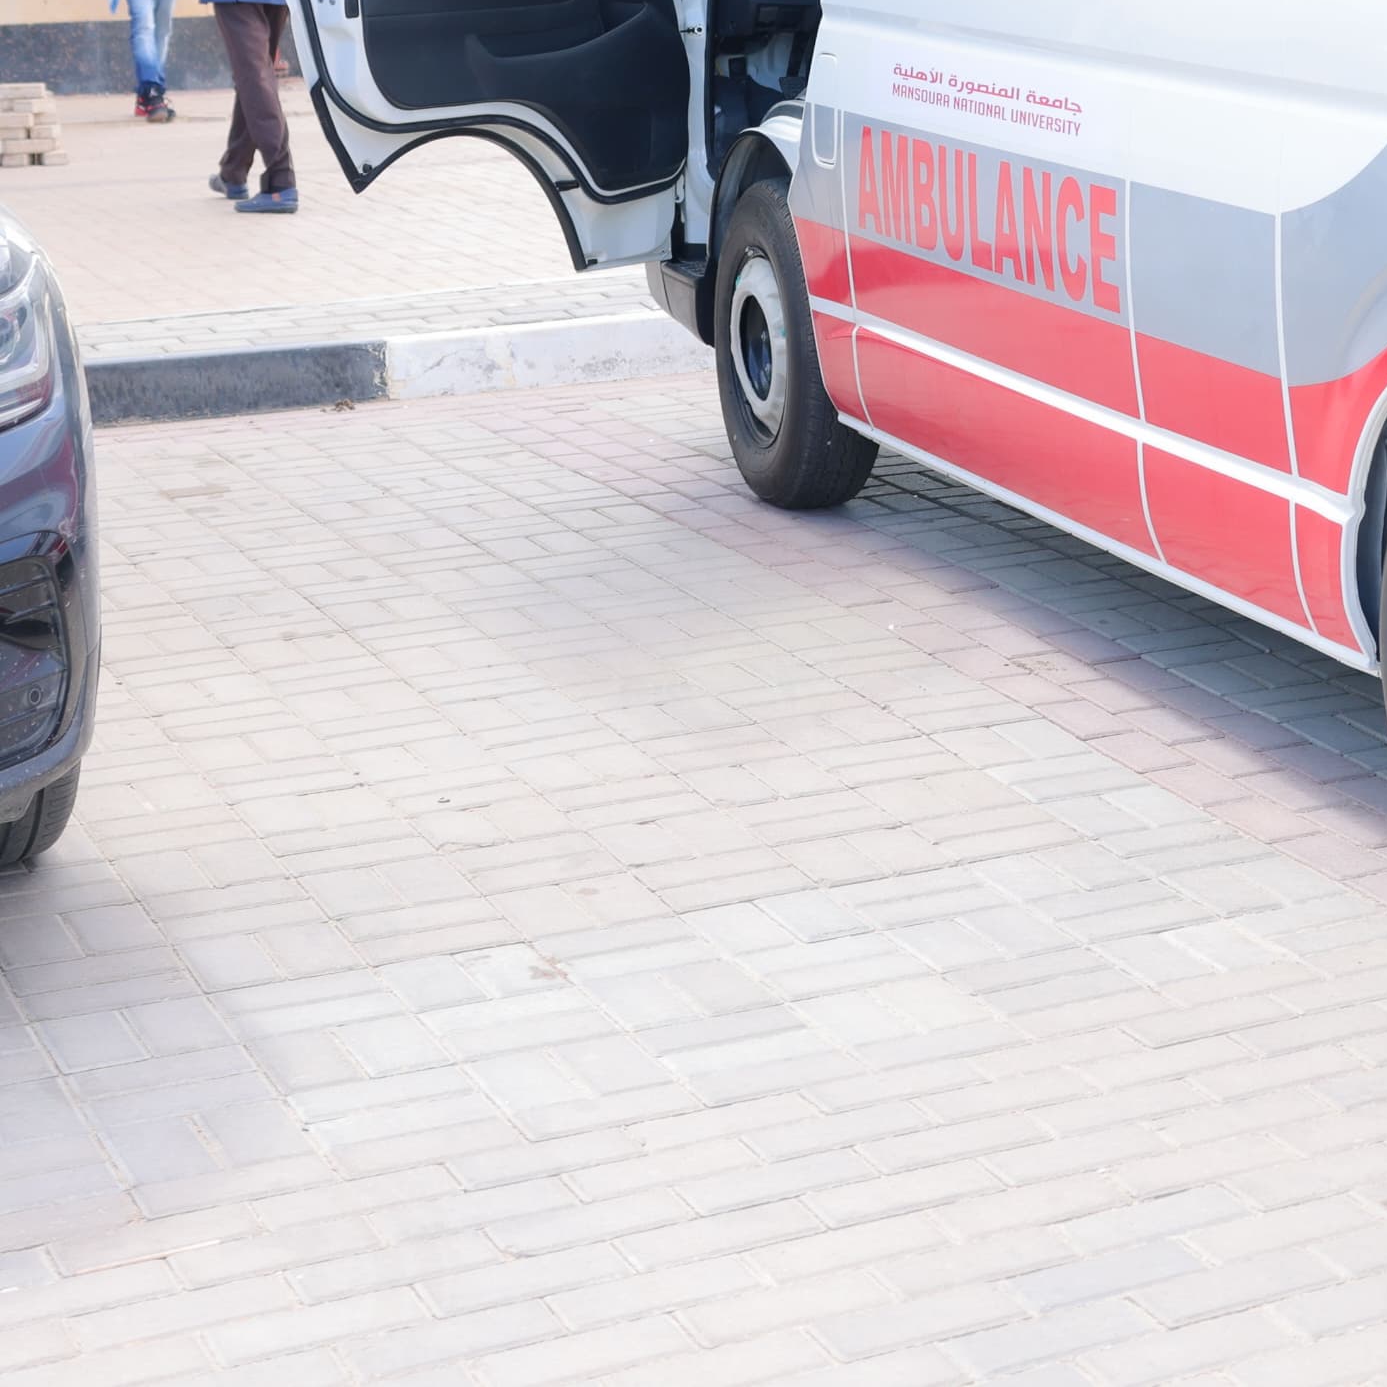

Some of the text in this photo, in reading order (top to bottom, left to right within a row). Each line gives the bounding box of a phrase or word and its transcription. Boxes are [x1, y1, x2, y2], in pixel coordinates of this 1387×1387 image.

[892, 82, 1081, 137] MANSOURA NATIONAL UNIVERSITY
[893, 63, 1082, 116] جامعة المنصورة الأهلية
[858, 125, 1120, 314] AMBULANCE
